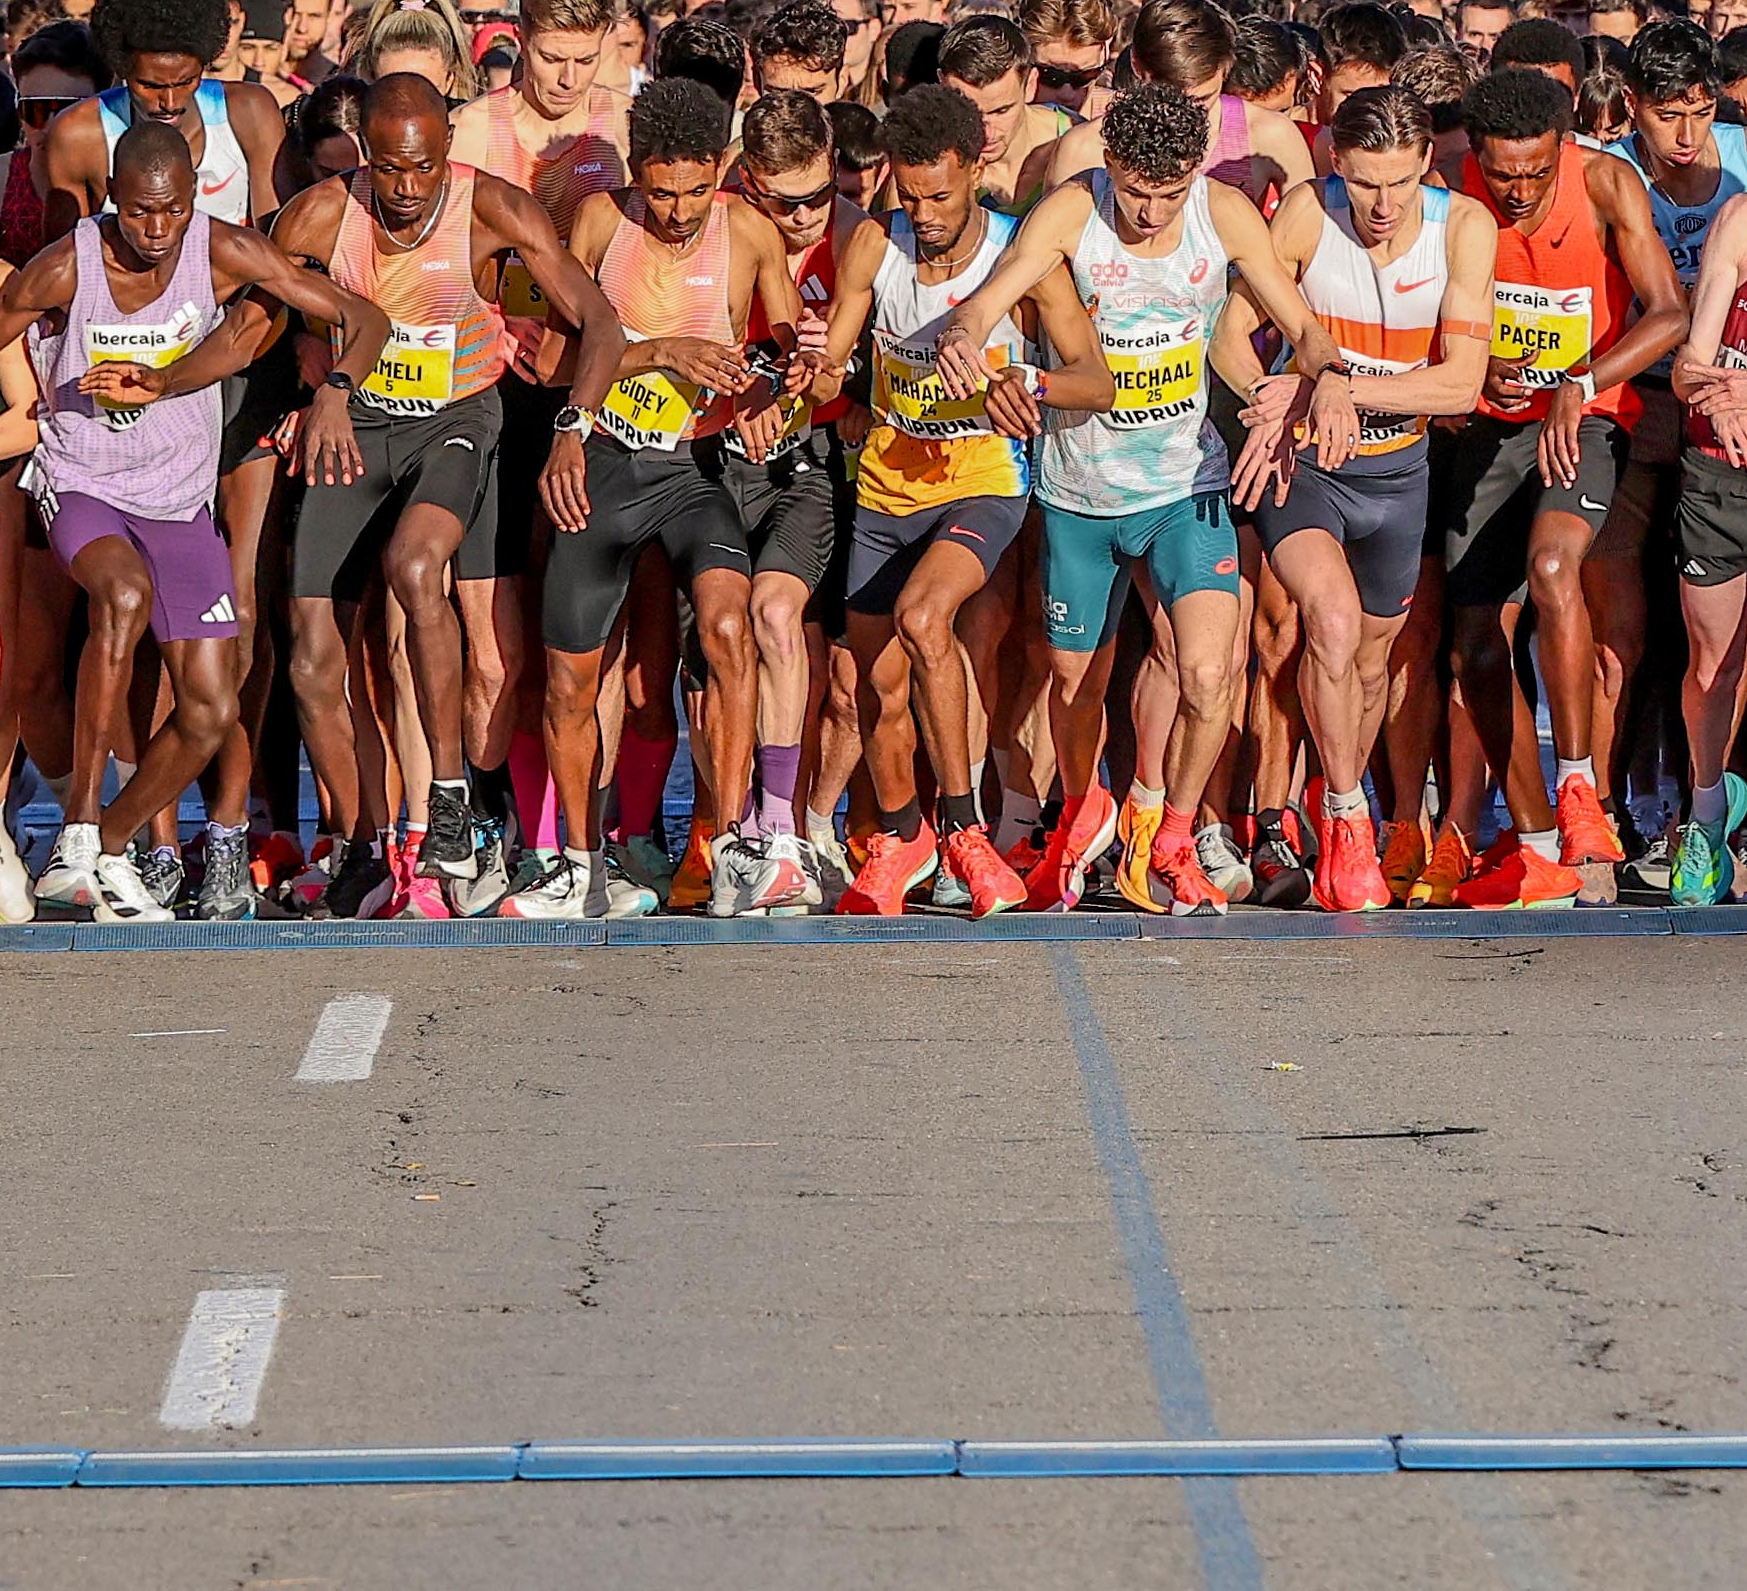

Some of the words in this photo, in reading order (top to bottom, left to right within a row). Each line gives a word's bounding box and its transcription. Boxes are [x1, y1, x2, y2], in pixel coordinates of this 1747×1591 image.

[1090, 261, 1129, 279] ada
[1495, 290, 1549, 309] ercaja
[93, 330, 166, 347] Ibercaja
[1101, 330, 1171, 349] Ibercaja
[1500, 324, 1561, 350] PACER
[880, 336, 937, 361] Ibercaja
[374, 359, 422, 382] IMELI
[1111, 360, 1194, 390] MECHAAL
[1341, 360, 1393, 377] ercaja
[385, 380, 394, 392] 5
[619, 378, 669, 411] GIDEY
[890, 374, 973, 402] MAHAM
[1146, 388, 1163, 403] 25
[919, 403, 937, 417] 24
[1110, 397, 1196, 424] KIPRUN
[897, 414, 979, 436] KIPRUN
